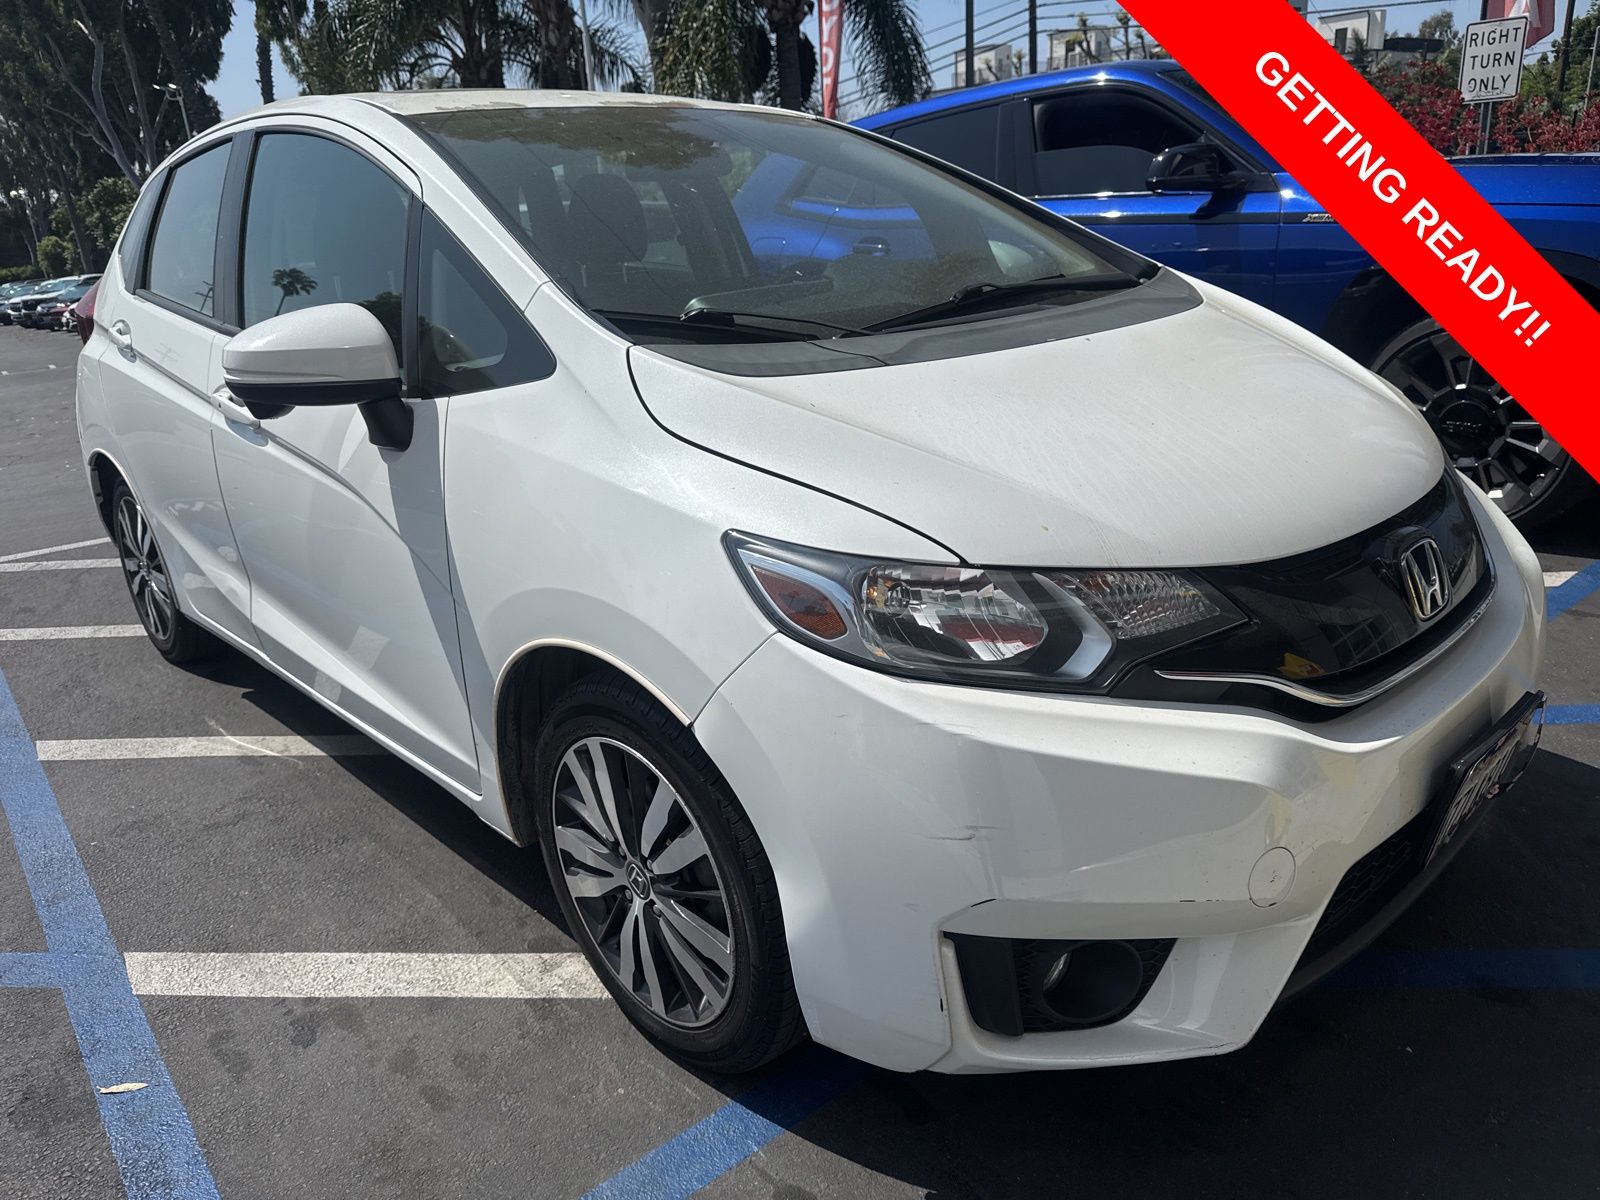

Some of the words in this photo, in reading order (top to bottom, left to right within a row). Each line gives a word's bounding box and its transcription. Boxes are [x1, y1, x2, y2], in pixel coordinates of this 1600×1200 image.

[1469, 27, 1521, 48] RIGHT
[1470, 51, 1515, 70] TURN
[1468, 74, 1511, 93] ONLY
